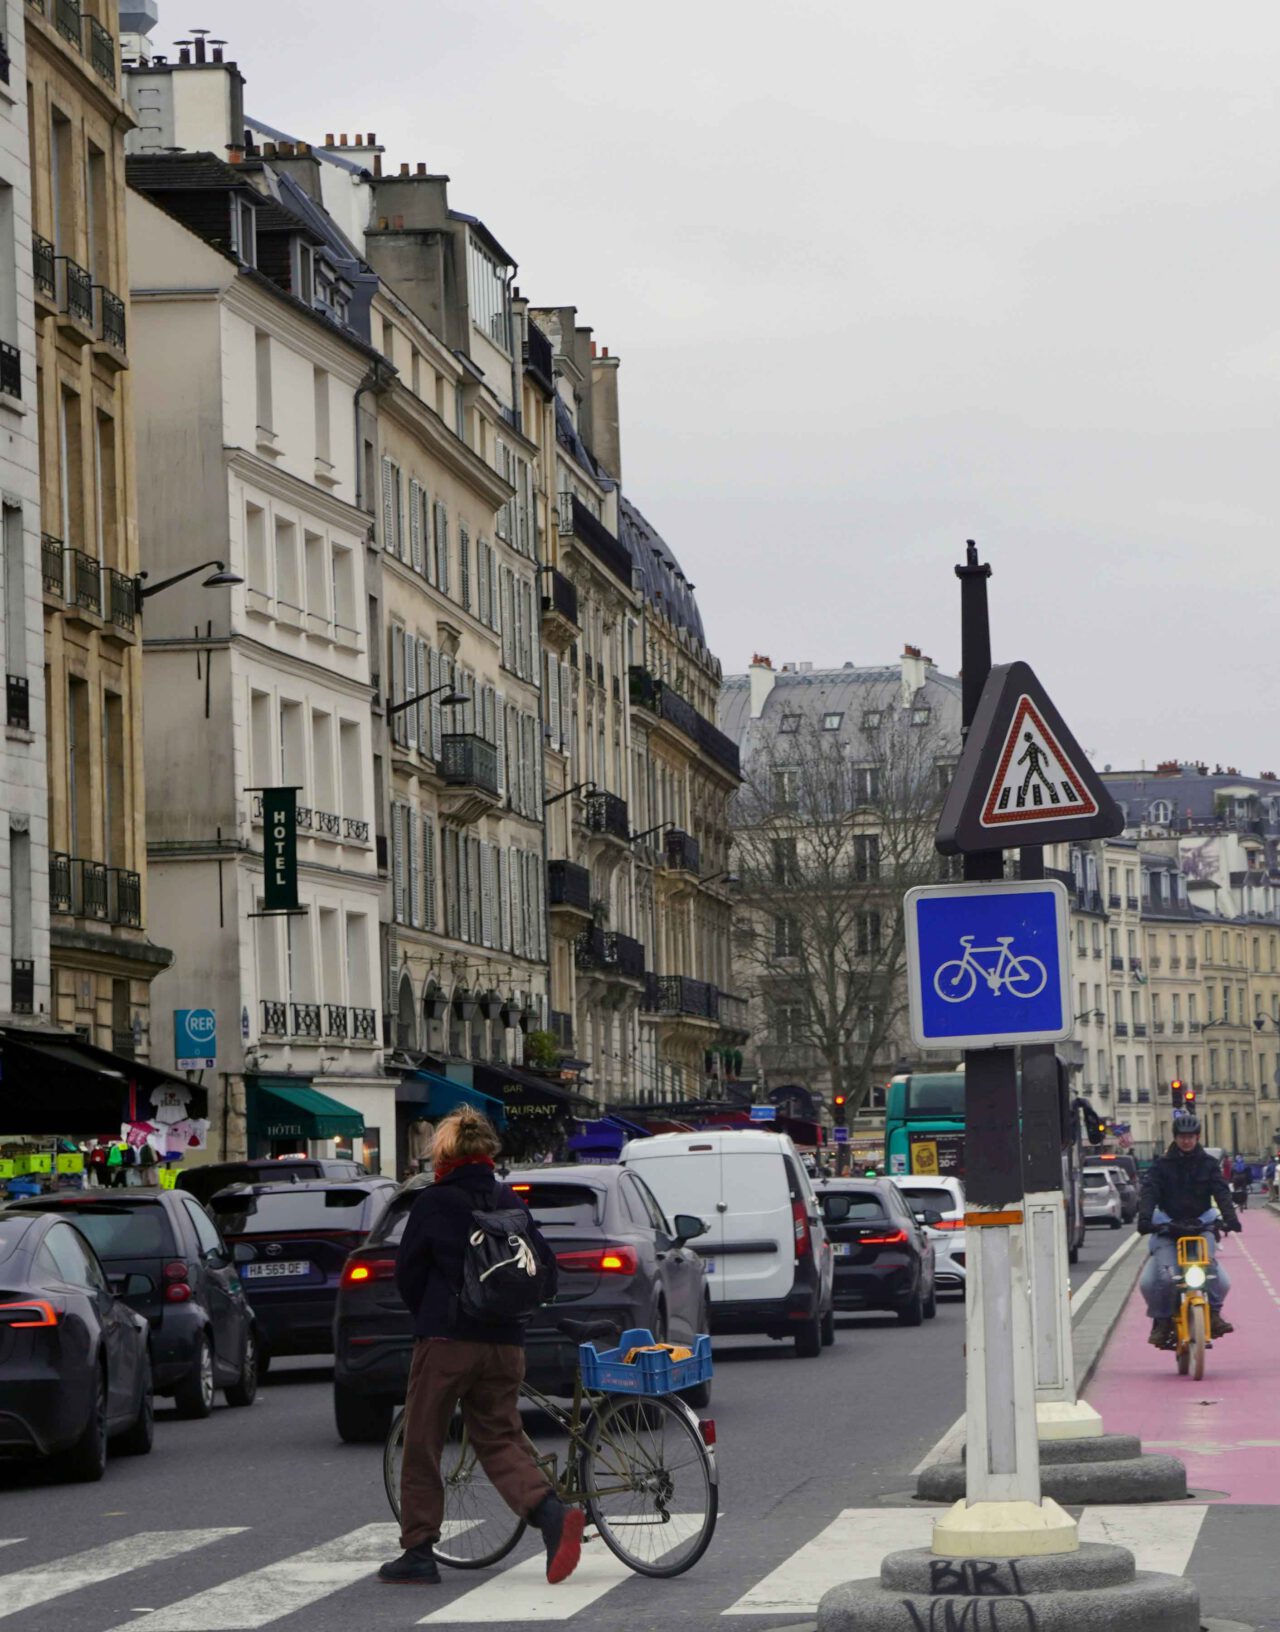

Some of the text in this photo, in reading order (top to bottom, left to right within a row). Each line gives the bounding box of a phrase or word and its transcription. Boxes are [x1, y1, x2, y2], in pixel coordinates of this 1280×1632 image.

[273, 811, 286, 885] HOTEL
[190, 1017, 214, 1030] RER
[504, 1104, 557, 1115] TAURANT
[267, 1123, 303, 1136] HÔTEL
